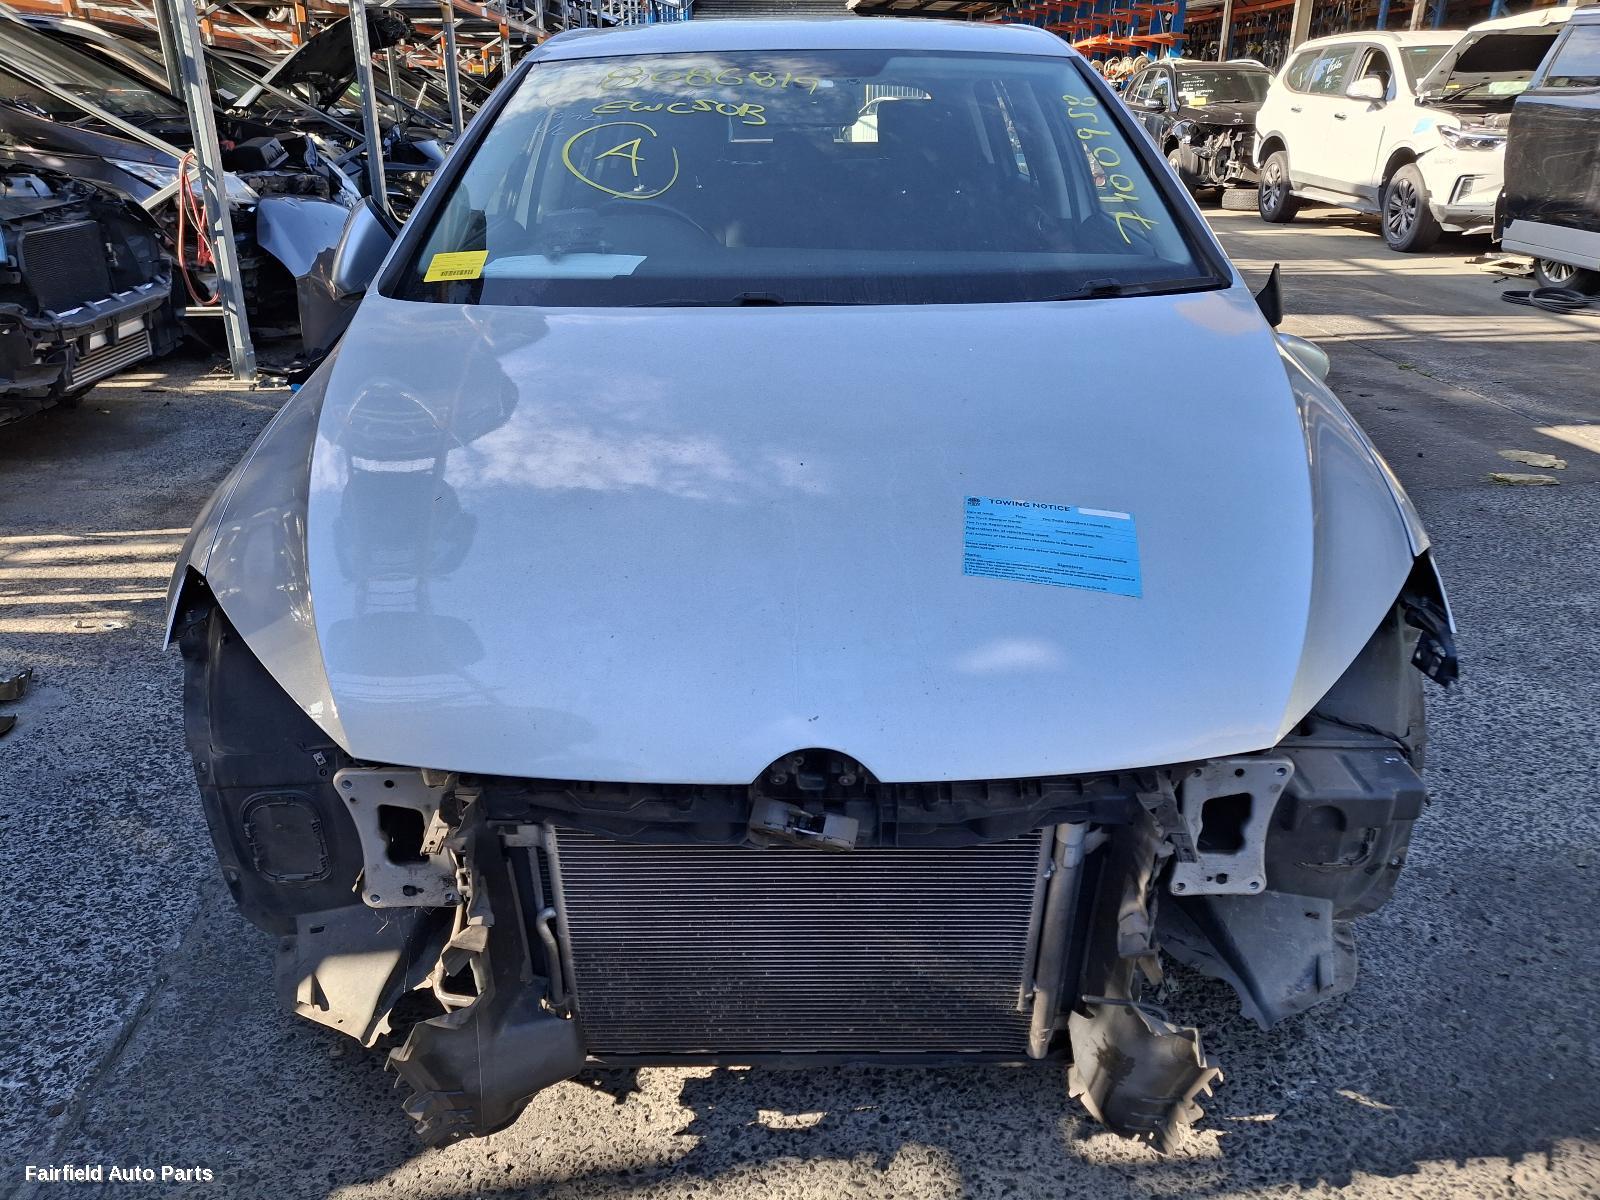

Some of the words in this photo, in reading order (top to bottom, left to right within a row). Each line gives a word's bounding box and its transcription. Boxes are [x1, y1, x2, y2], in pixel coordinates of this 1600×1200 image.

[600, 65, 820, 95] 8086819
[594, 137, 645, 177] A
[988, 498, 1030, 508] TOWING
[1032, 502, 1071, 511] NOTICE
